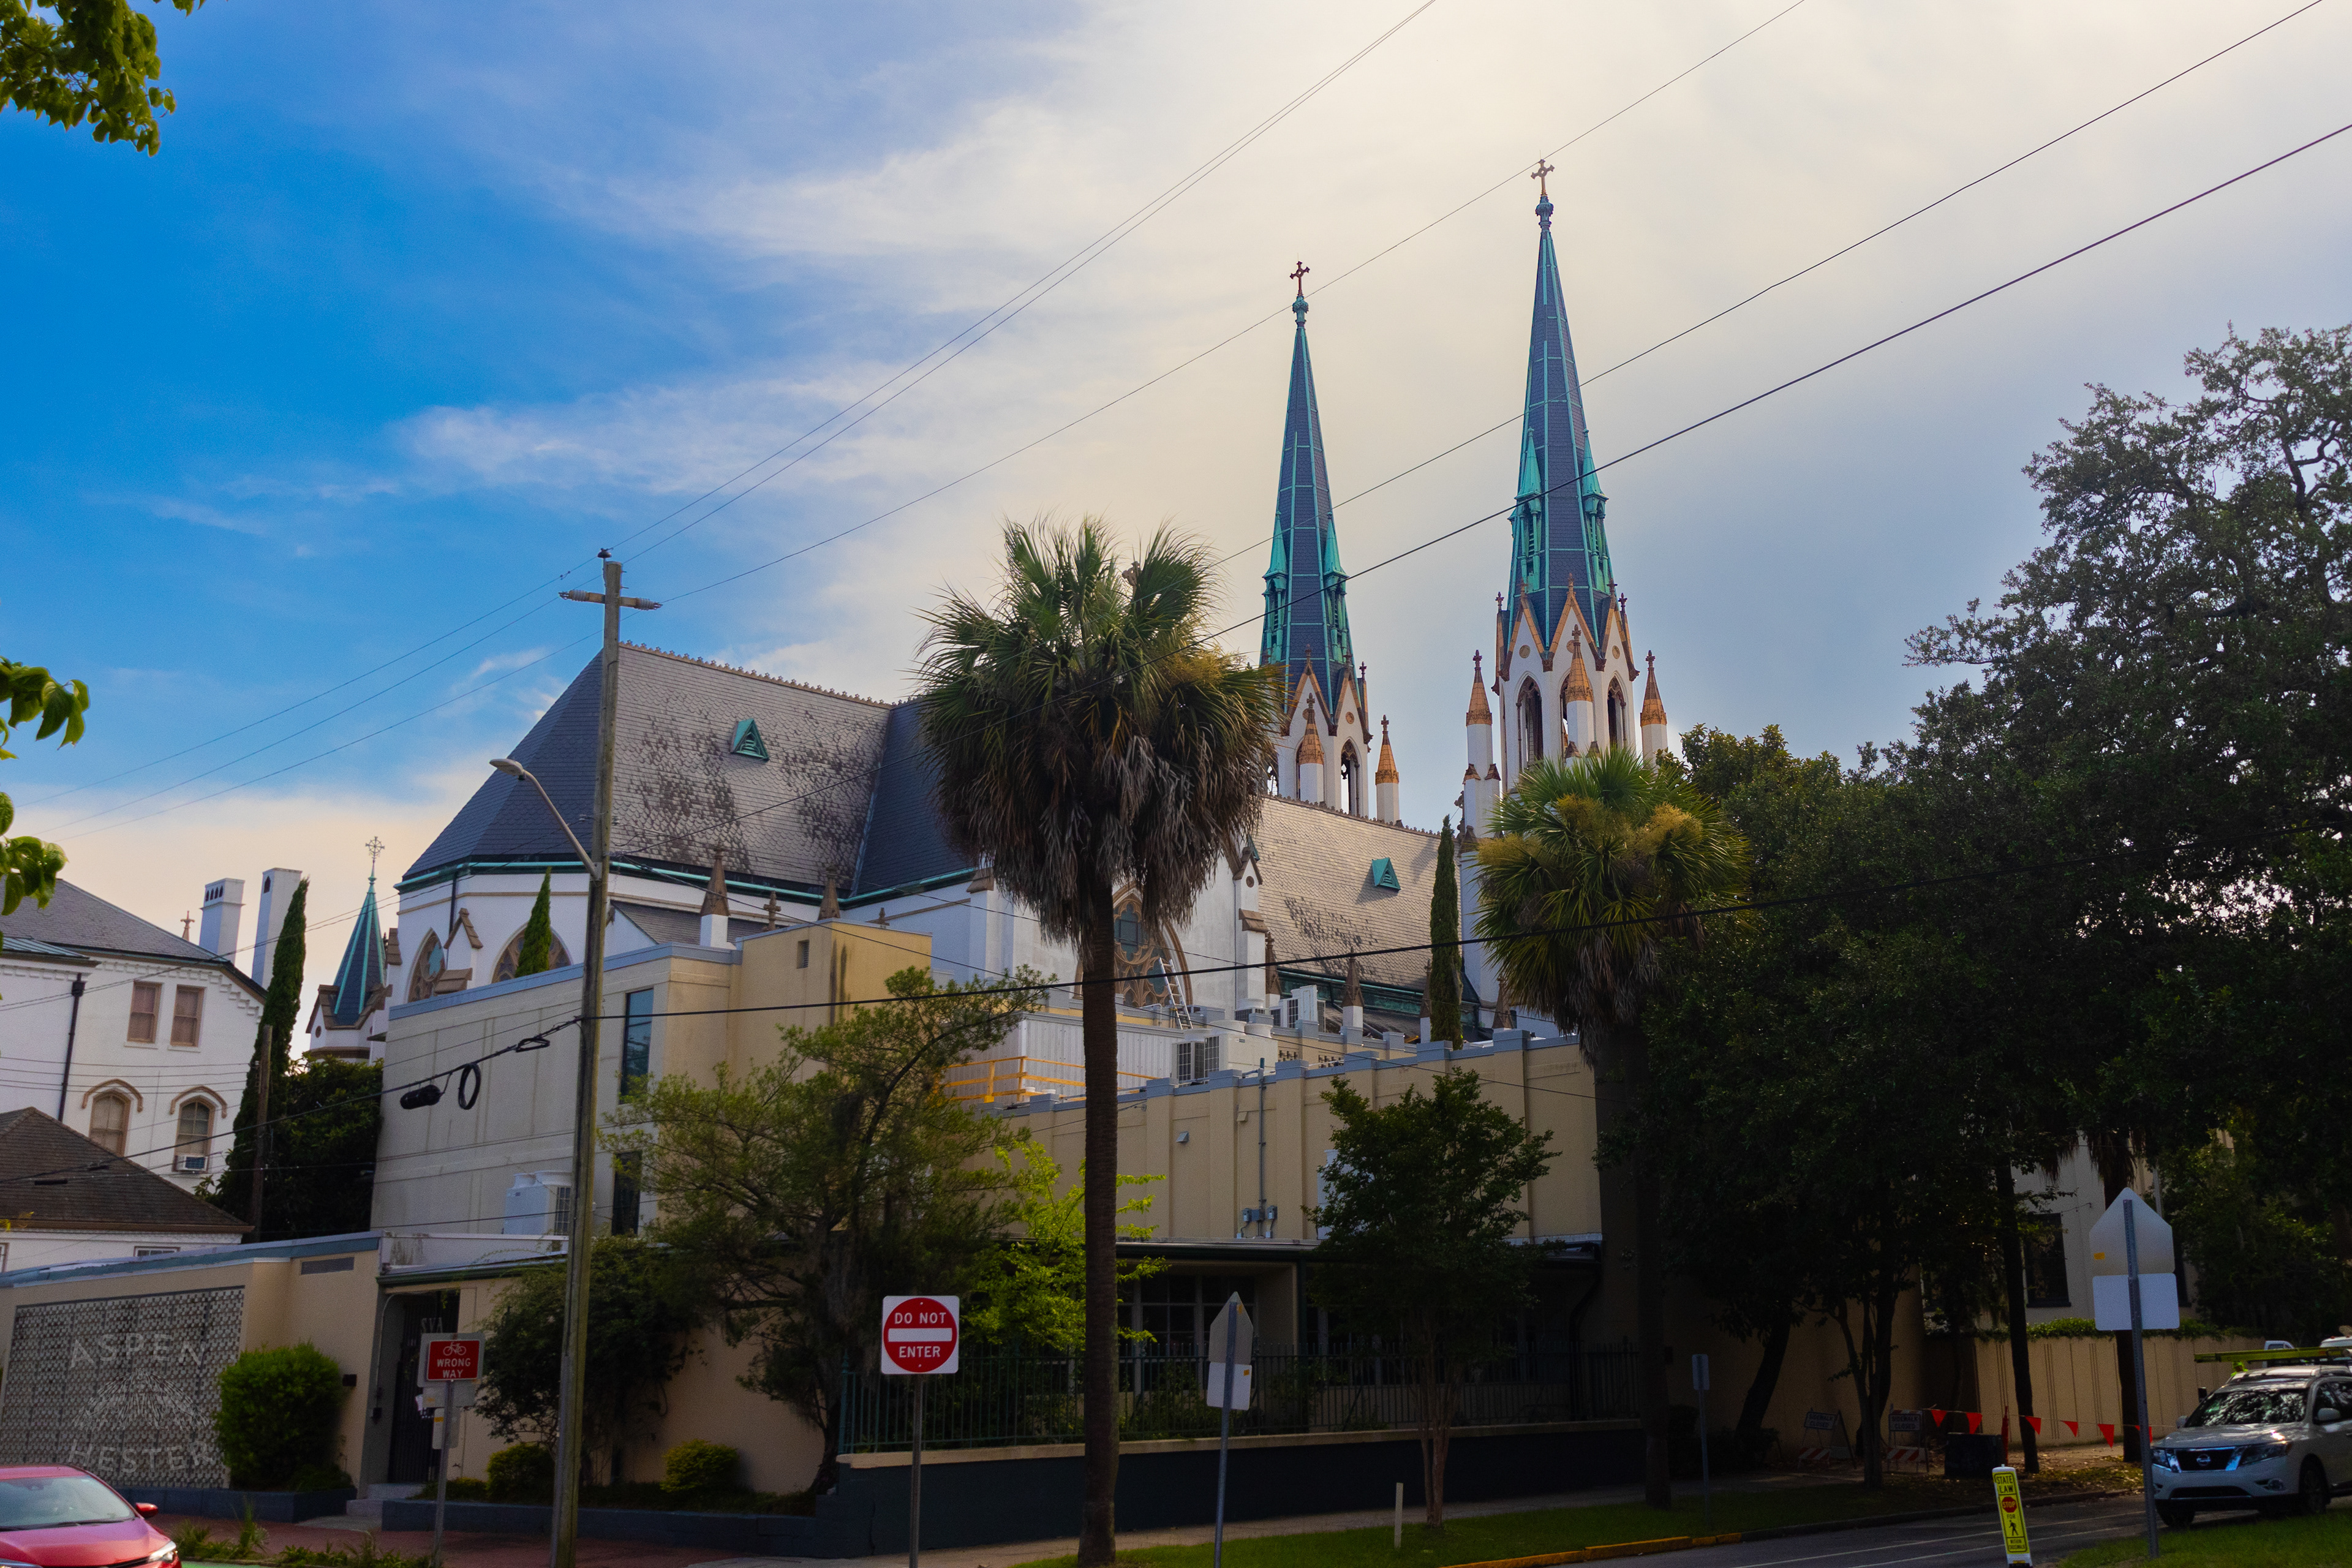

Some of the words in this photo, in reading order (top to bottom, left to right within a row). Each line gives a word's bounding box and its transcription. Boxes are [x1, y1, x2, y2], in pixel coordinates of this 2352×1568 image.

[894, 1312, 913, 1324] DO
[919, 1312, 946, 1324] NOT
[899, 1346, 941, 1358] ENTER
[437, 1358, 471, 1367] WRONG
[442, 1370, 464, 1378] WAY
[1996, 1476, 2013, 1485] STATE
